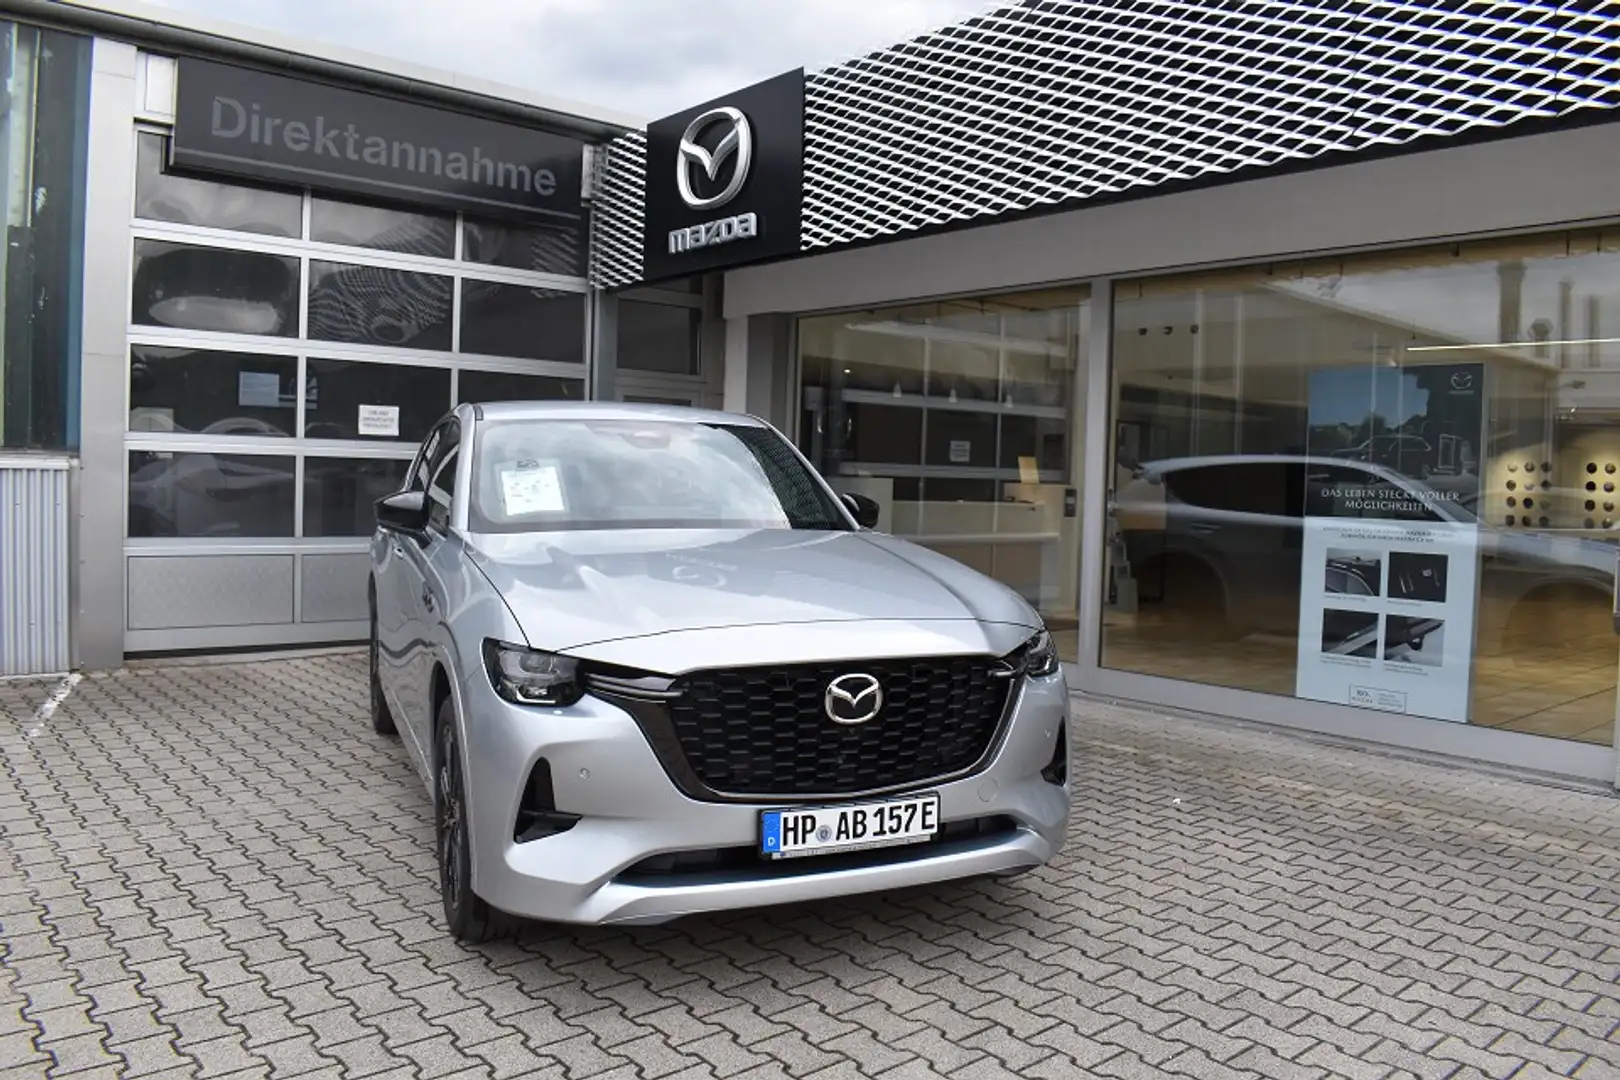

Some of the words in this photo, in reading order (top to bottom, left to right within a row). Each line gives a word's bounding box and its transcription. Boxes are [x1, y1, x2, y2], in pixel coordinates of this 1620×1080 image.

[211, 96, 558, 196] Direktannahme
[1321, 488, 1342, 498] DAS
[1344, 489, 1376, 498] LEBEN
[1419, 490, 1460, 501] VOLLER
[1344, 498, 1432, 511] MÖGLICHKEITEN
[783, 814, 816, 846] HP
[836, 811, 867, 841] AB
[873, 802, 935, 836] 157E
[767, 836, 776, 847] D
